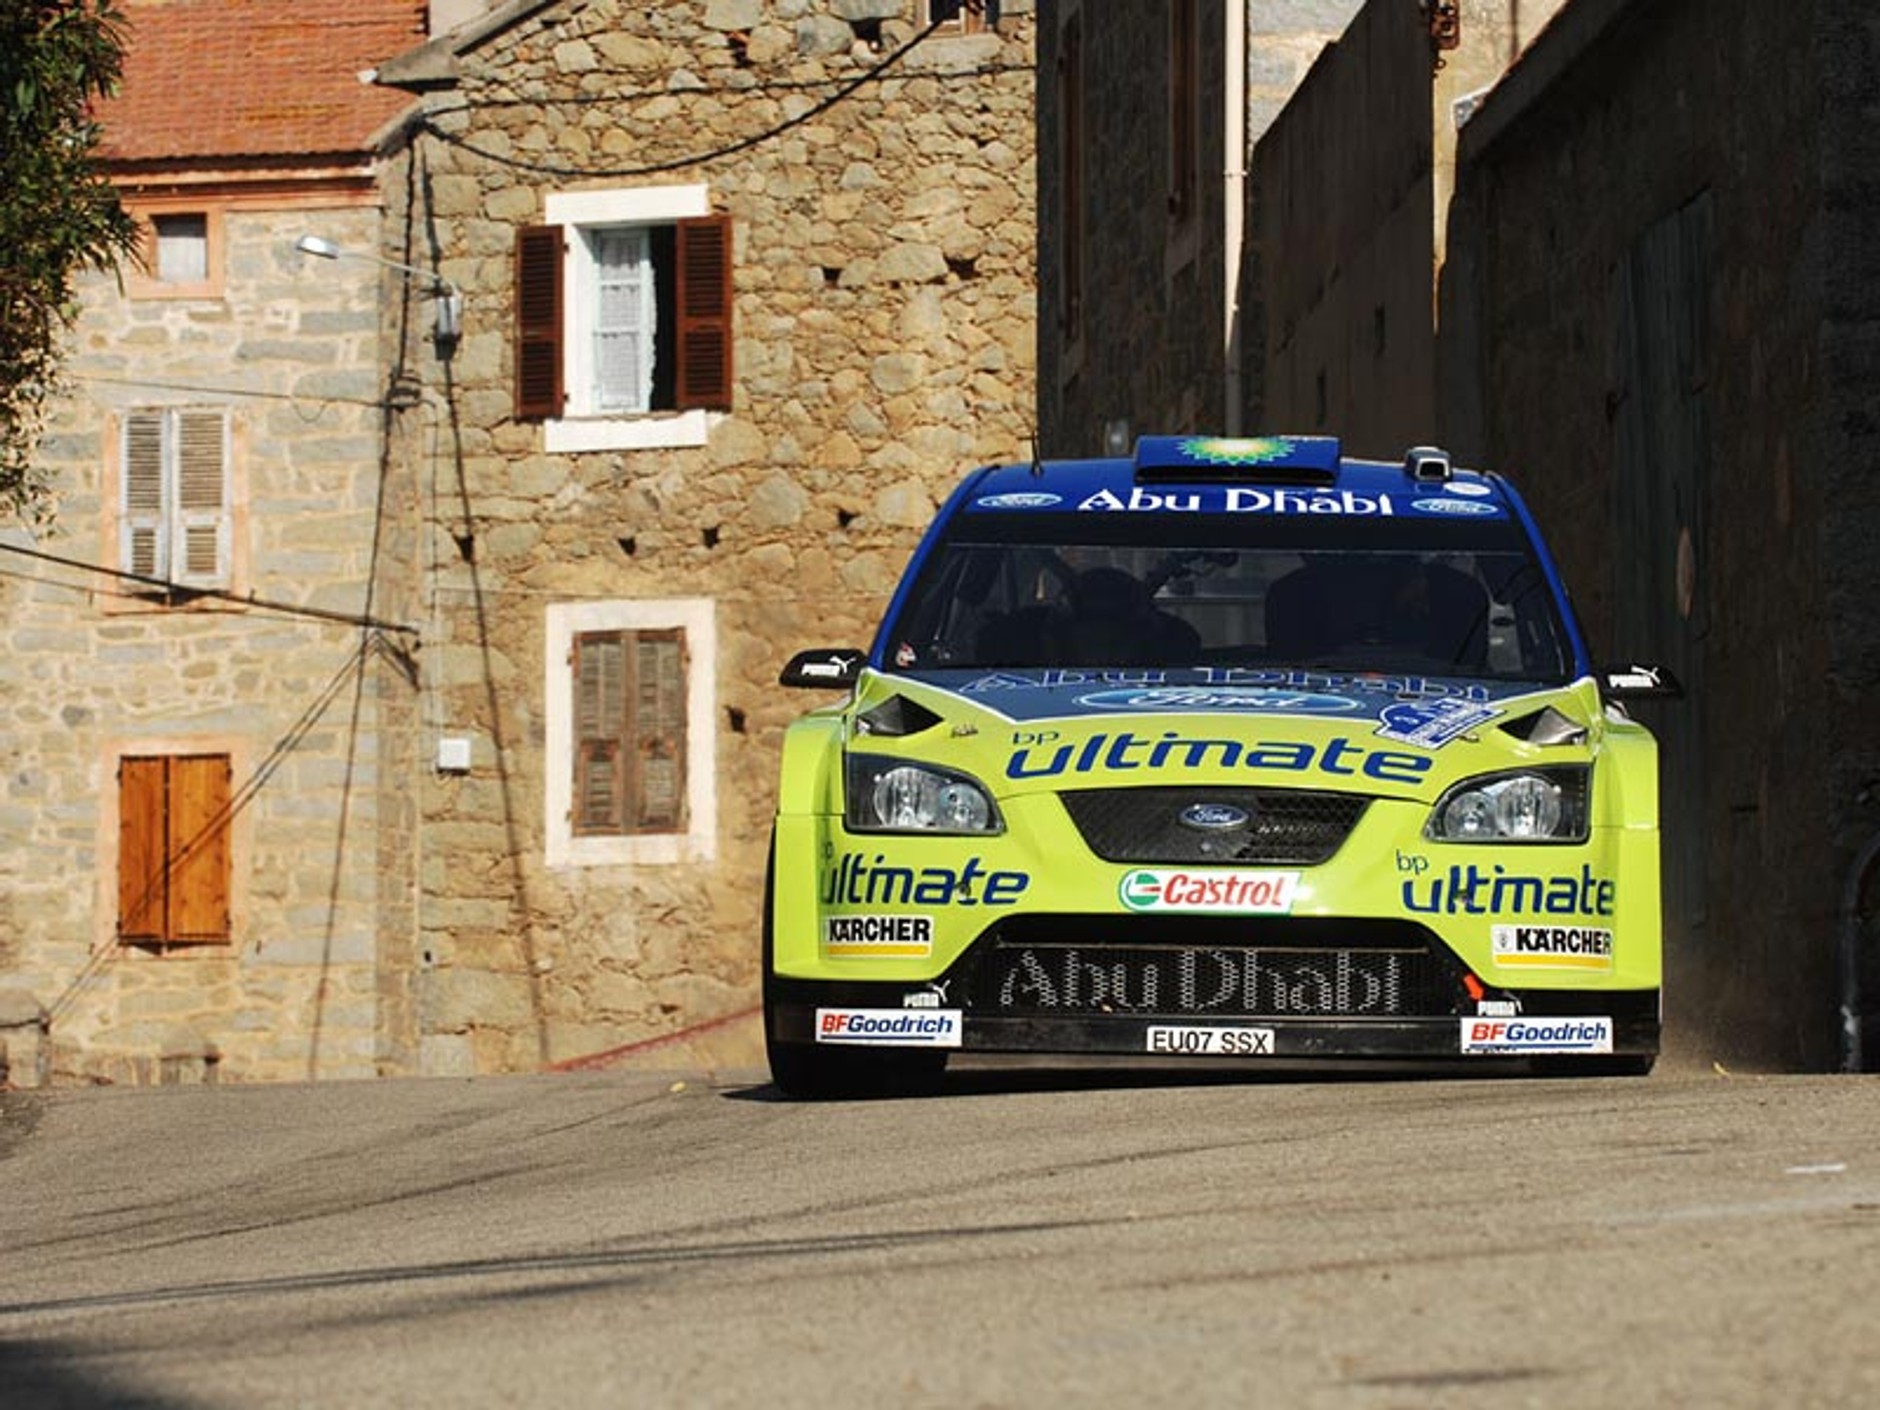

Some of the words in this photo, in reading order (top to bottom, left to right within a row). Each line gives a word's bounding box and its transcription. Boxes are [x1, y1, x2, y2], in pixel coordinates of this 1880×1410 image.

[1077, 488, 1200, 511] Abu
[1225, 487, 1393, 515] Dhabi
[958, 668, 1165, 693] Abu
[1006, 732, 1432, 784] ultimate
[1396, 849, 1429, 874] bp
[820, 853, 1030, 905] ultimate
[1163, 873, 1284, 906] Castrol
[1402, 863, 1615, 915] ultimate
[829, 918, 931, 942] KÄRCHER
[1516, 928, 1611, 955] KÄRCHER
[1000, 950, 1157, 1008] Abu
[1180, 949, 1400, 1012] Dhabi
[821, 1014, 953, 1033] BFGoodrich
[1471, 1022, 1606, 1041] BFGoodrich
[1152, 1030, 1214, 1051] EU07
[1221, 1031, 1268, 1052] SSX
